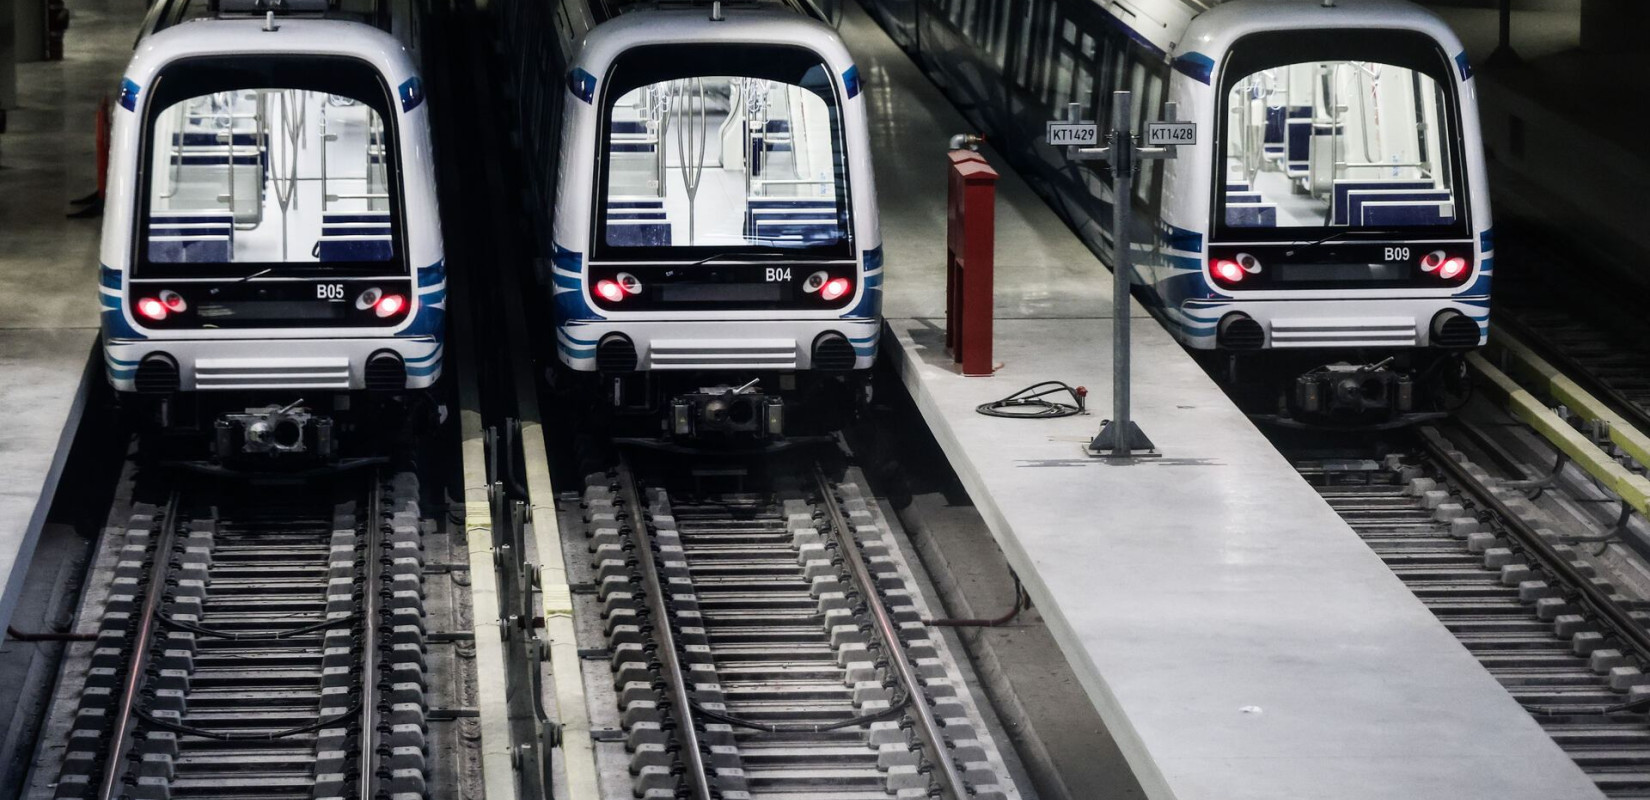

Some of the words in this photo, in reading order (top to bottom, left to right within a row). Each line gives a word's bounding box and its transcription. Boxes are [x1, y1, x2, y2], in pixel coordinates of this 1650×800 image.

[1053, 128, 1095, 141] KT1429
[1151, 128, 1194, 141] KT1428
[1384, 247, 1410, 261] B09
[765, 267, 792, 282] B04
[317, 284, 344, 299] B05
